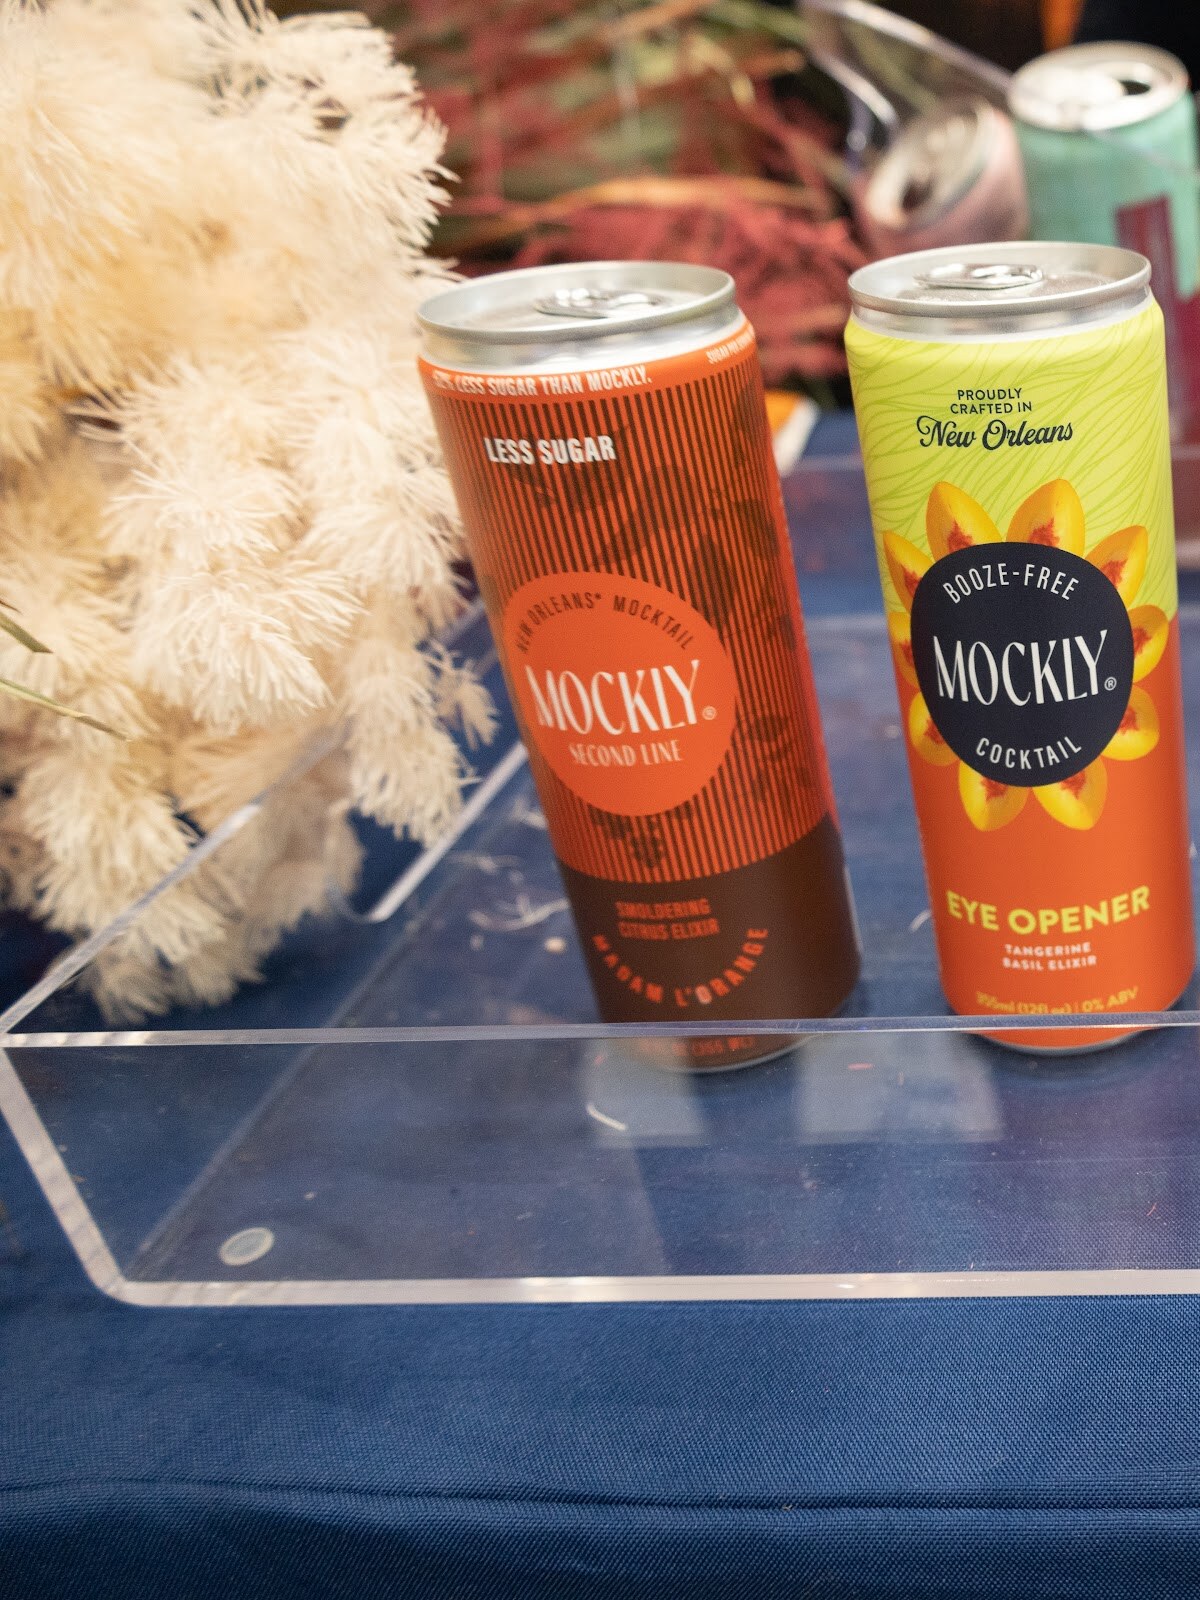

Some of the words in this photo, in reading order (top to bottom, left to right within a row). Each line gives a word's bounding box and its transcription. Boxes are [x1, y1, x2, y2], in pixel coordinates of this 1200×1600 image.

[455, 375, 486, 395] LESS
[486, 376, 539, 397] SUGAR
[539, 372, 583, 396] THAN
[586, 364, 652, 392] MOCKLY.
[957, 388, 1022, 400] PROUDLY
[950, 402, 1012, 414] CRAFTED
[1018, 401, 1032, 412] IN
[916, 415, 976, 447] New
[982, 418, 1073, 450] Orleans
[483, 437, 535, 465] LESS
[538, 435, 617, 465] SUGAR
[942, 563, 1080, 604] BOOZE-FREE
[612, 593, 695, 652] MOCKTAIL
[567, 743, 638, 767] SECOND
[641, 738, 685, 766] LINE
[976, 736, 1082, 770] COCKTAIL
[946, 889, 1000, 932] EYE
[1007, 885, 1150, 936] OPENER
[1004, 942, 1092, 957] TANGERINE
